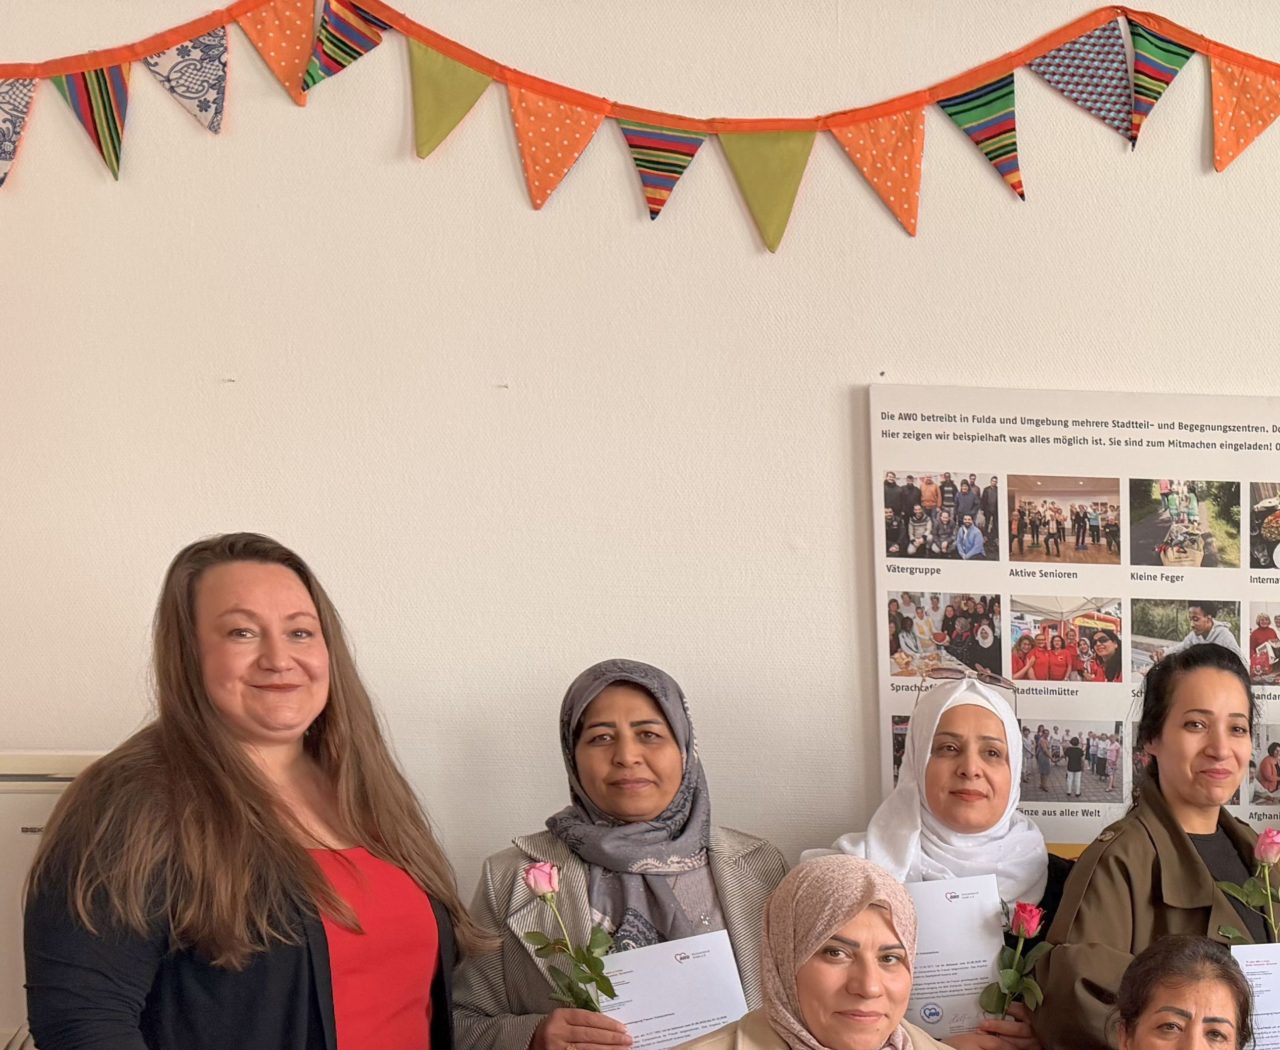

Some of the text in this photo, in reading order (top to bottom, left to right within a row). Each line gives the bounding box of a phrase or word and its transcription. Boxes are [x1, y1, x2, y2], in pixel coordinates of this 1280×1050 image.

[880, 410, 895, 421] Die
[898, 411, 918, 422] AWO
[920, 412, 957, 424] betreibt
[959, 413, 969, 424] in
[971, 414, 997, 425] Fulda
[999, 415, 1017, 425] und
[1020, 417, 1069, 429] Umgebung
[1072, 418, 1109, 429] mehrere
[1111, 419, 1155, 430] Stadtteil-
[1157, 421, 1175, 431] und
[1178, 422, 1269, 434] Begegnungszentren.
[881, 428, 900, 439] Hier
[902, 430, 933, 442] zeigen
[935, 431, 950, 441] wir
[952, 432, 1007, 444] beispielhaft
[1009, 435, 1027, 444] was
[1029, 434, 1050, 445] alles
[1053, 435, 1089, 447] möglich
[1091, 435, 1106, 447] ist.
[1108, 436, 1121, 447] Sie
[1124, 437, 1143, 448] sind
[1146, 440, 1165, 448] zum
[1168, 438, 1217, 450] Mitmachen
[1219, 441, 1272, 453] eingeladen!
[886, 564, 941, 577] Vätergruppe
[1009, 568, 1078, 580] Aktive Senioren
[1130, 571, 1184, 584] Kleine Feger
[1014, 686, 1079, 696] tadtteilmütter
[1041, 809, 1057, 817] aus
[1060, 808, 1079, 817] aller
[1081, 808, 1101, 818] Welt
